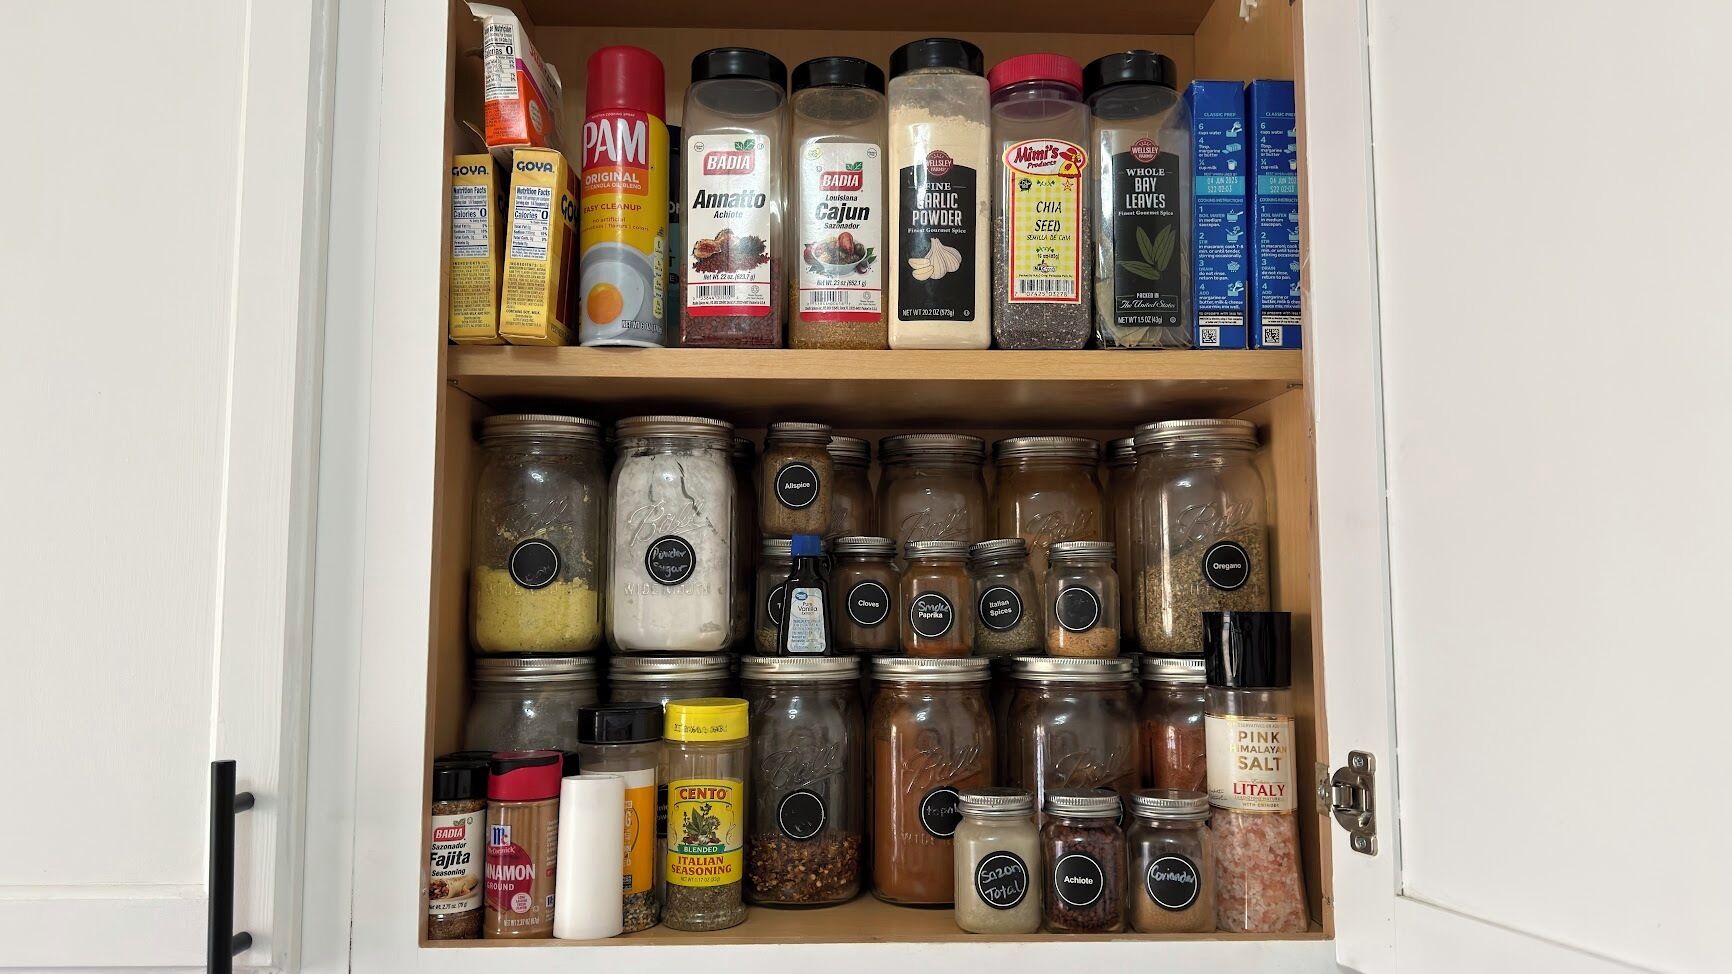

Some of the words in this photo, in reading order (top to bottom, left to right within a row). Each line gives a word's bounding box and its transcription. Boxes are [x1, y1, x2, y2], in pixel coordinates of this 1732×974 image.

[583, 118, 646, 168] PAM
[1014, 145, 1059, 163] Mimi's
[517, 161, 552, 172] GOYA
[707, 156, 750, 170] BADIA
[1027, 160, 1056, 168] Products
[452, 166, 486, 176] GOYA
[586, 171, 639, 185] ORIGINAL
[823, 175, 858, 187] BADIA
[1135, 177, 1157, 192] BAY
[692, 189, 766, 209] Annatto
[917, 193, 958, 209] GARLIC
[1126, 194, 1165, 208] LEAVES
[480, 208, 486, 217] 0
[584, 204, 598, 214] EASY
[815, 202, 870, 223] Cajun
[1036, 201, 1062, 213] CHIA
[542, 211, 548, 219] 0
[713, 210, 743, 219] Achiote
[913, 210, 962, 226] POWDER
[1035, 220, 1060, 232] SEED
[1120, 300, 1132, 308] The
[628, 499, 708, 547] Ball
[989, 600, 1009, 608] Italian
[990, 608, 1012, 616] Spices
[1239, 731, 1280, 743] PINK
[1238, 755, 1282, 771] SALT
[679, 788, 727, 801] CENTO
[1233, 783, 1285, 796] LITALY
[436, 828, 463, 839] BADIA
[430, 850, 470, 869] Fajita
[678, 856, 724, 865] ITALIAN
[485, 863, 536, 881] NNAMON
[672, 864, 732, 876] SEASONING
[981, 865, 1021, 884] Sazon
[1151, 864, 1195, 884] Coriander
[1064, 875, 1093, 885] Achiote
[487, 882, 514, 891] GROUND
[985, 882, 1022, 901] Total
